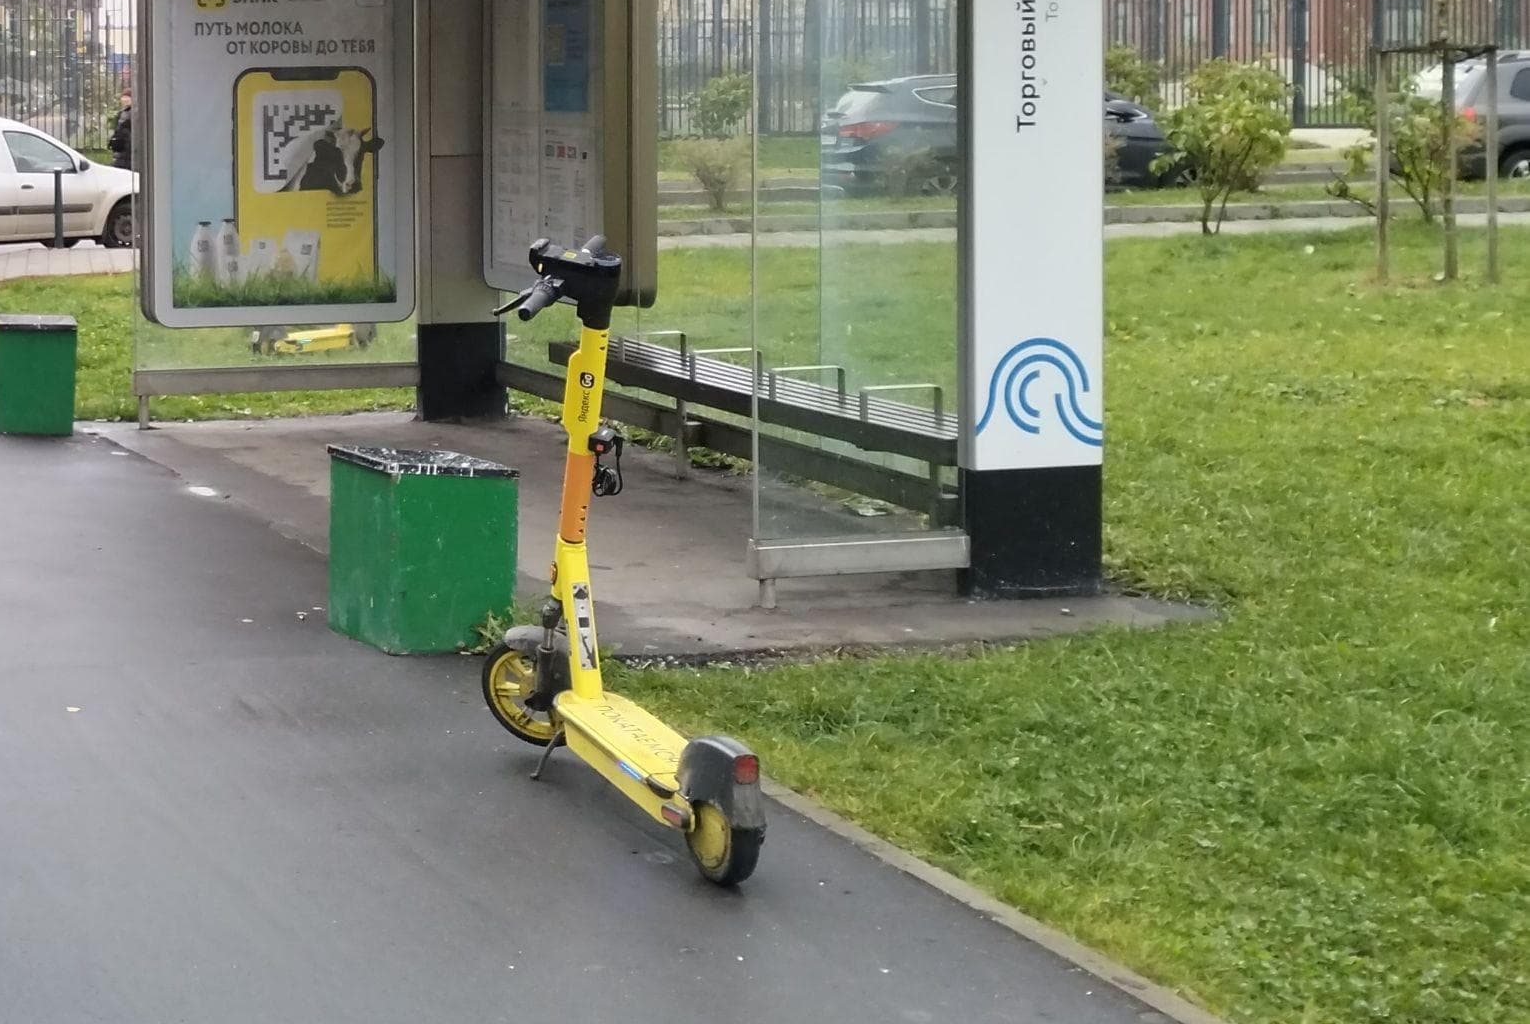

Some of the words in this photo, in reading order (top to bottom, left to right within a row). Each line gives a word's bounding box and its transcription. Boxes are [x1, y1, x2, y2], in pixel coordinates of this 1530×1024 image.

[194, 22, 233, 36] ПУТЬ
[236, 21, 304, 36] МОЛОКА
[226, 41, 246, 55] ОТ
[250, 40, 313, 55] КОРОВЫ
[316, 40, 338, 56] ДО
[341, 39, 376, 54] ТЕБЯ
[581, 373, 593, 387] Go
[577, 390, 591, 423] Яндекс
